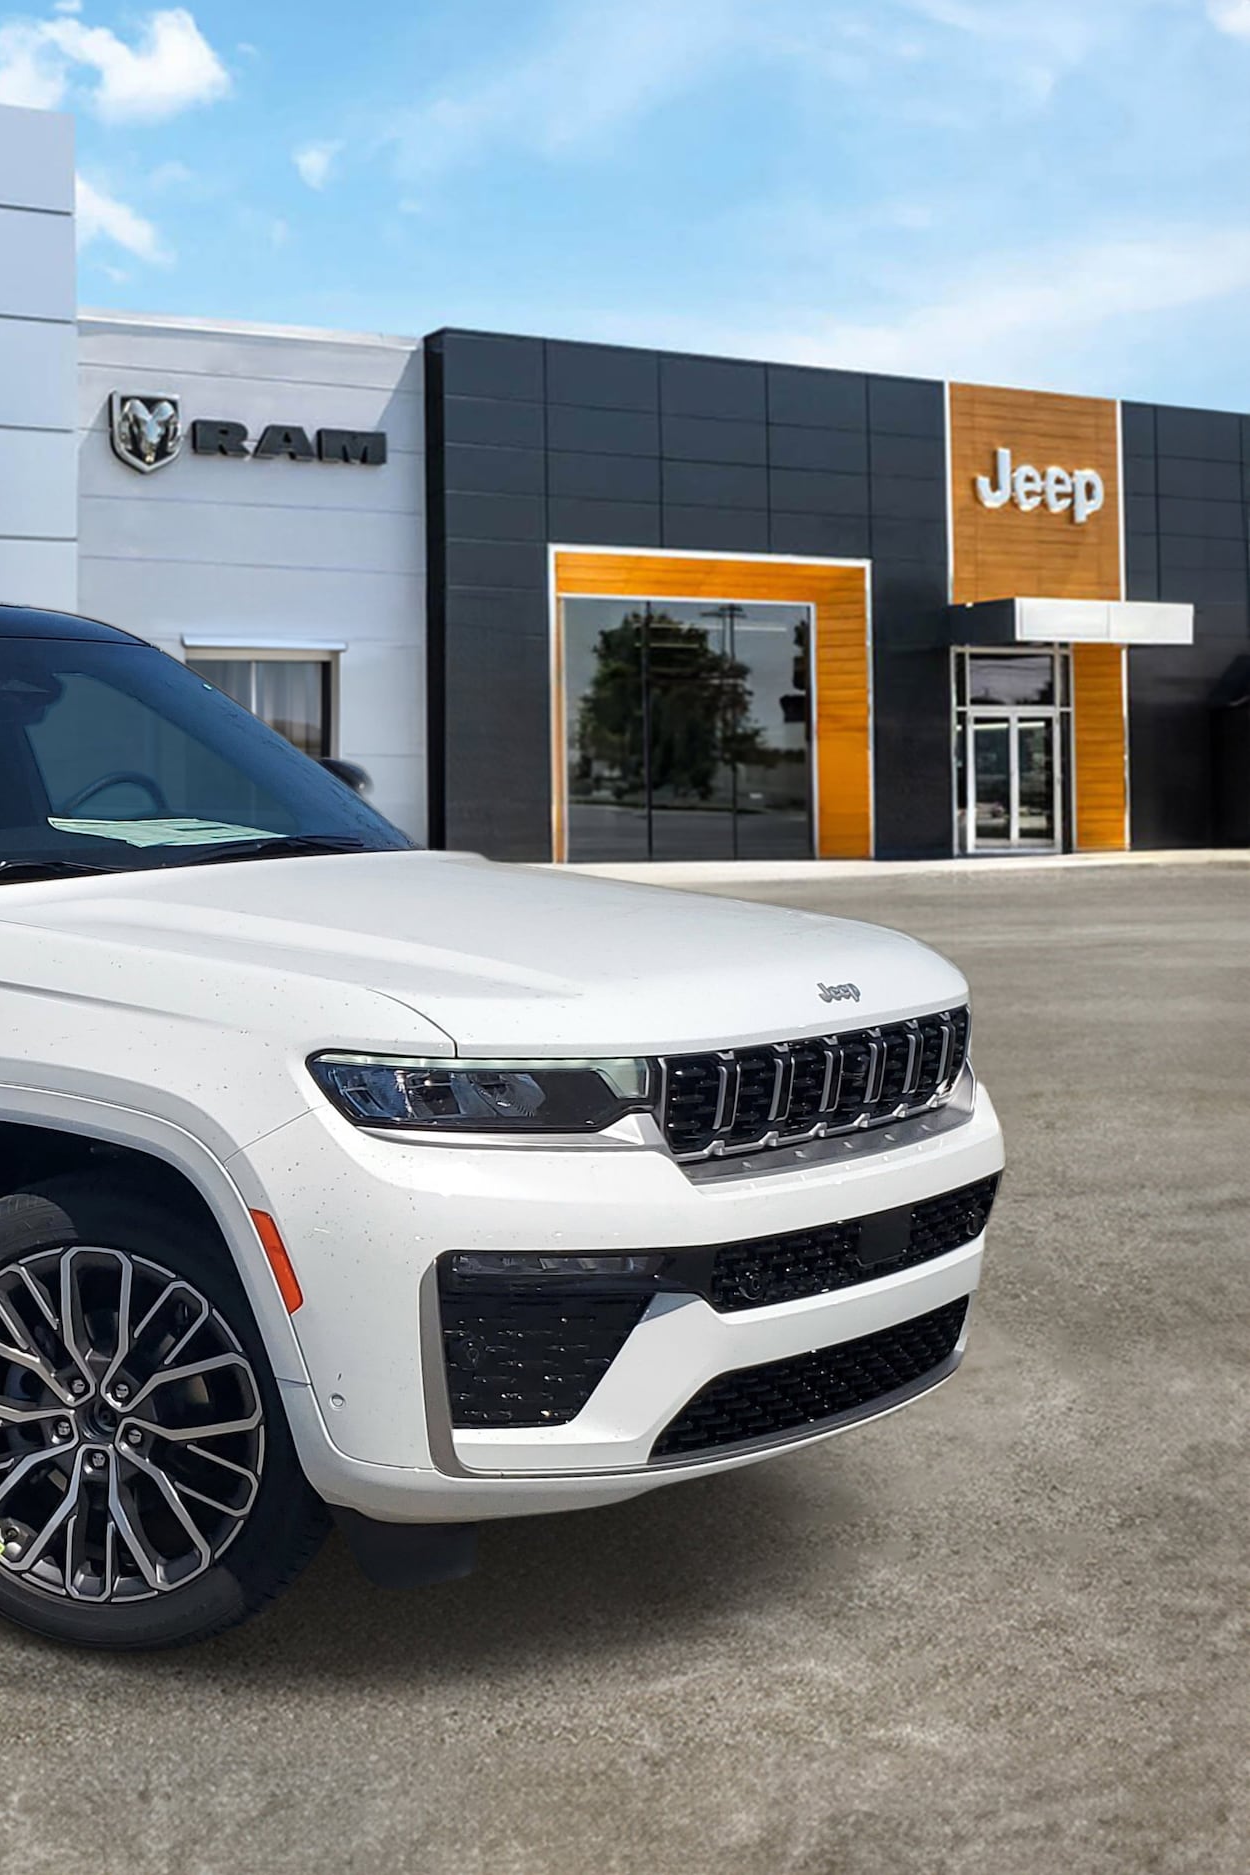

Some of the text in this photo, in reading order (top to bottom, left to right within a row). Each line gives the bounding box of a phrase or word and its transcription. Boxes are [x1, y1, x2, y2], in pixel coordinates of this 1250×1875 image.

[191, 419, 388, 465] RAM
[976, 447, 1105, 524] Jeep
[816, 982, 861, 1003] Jeep
